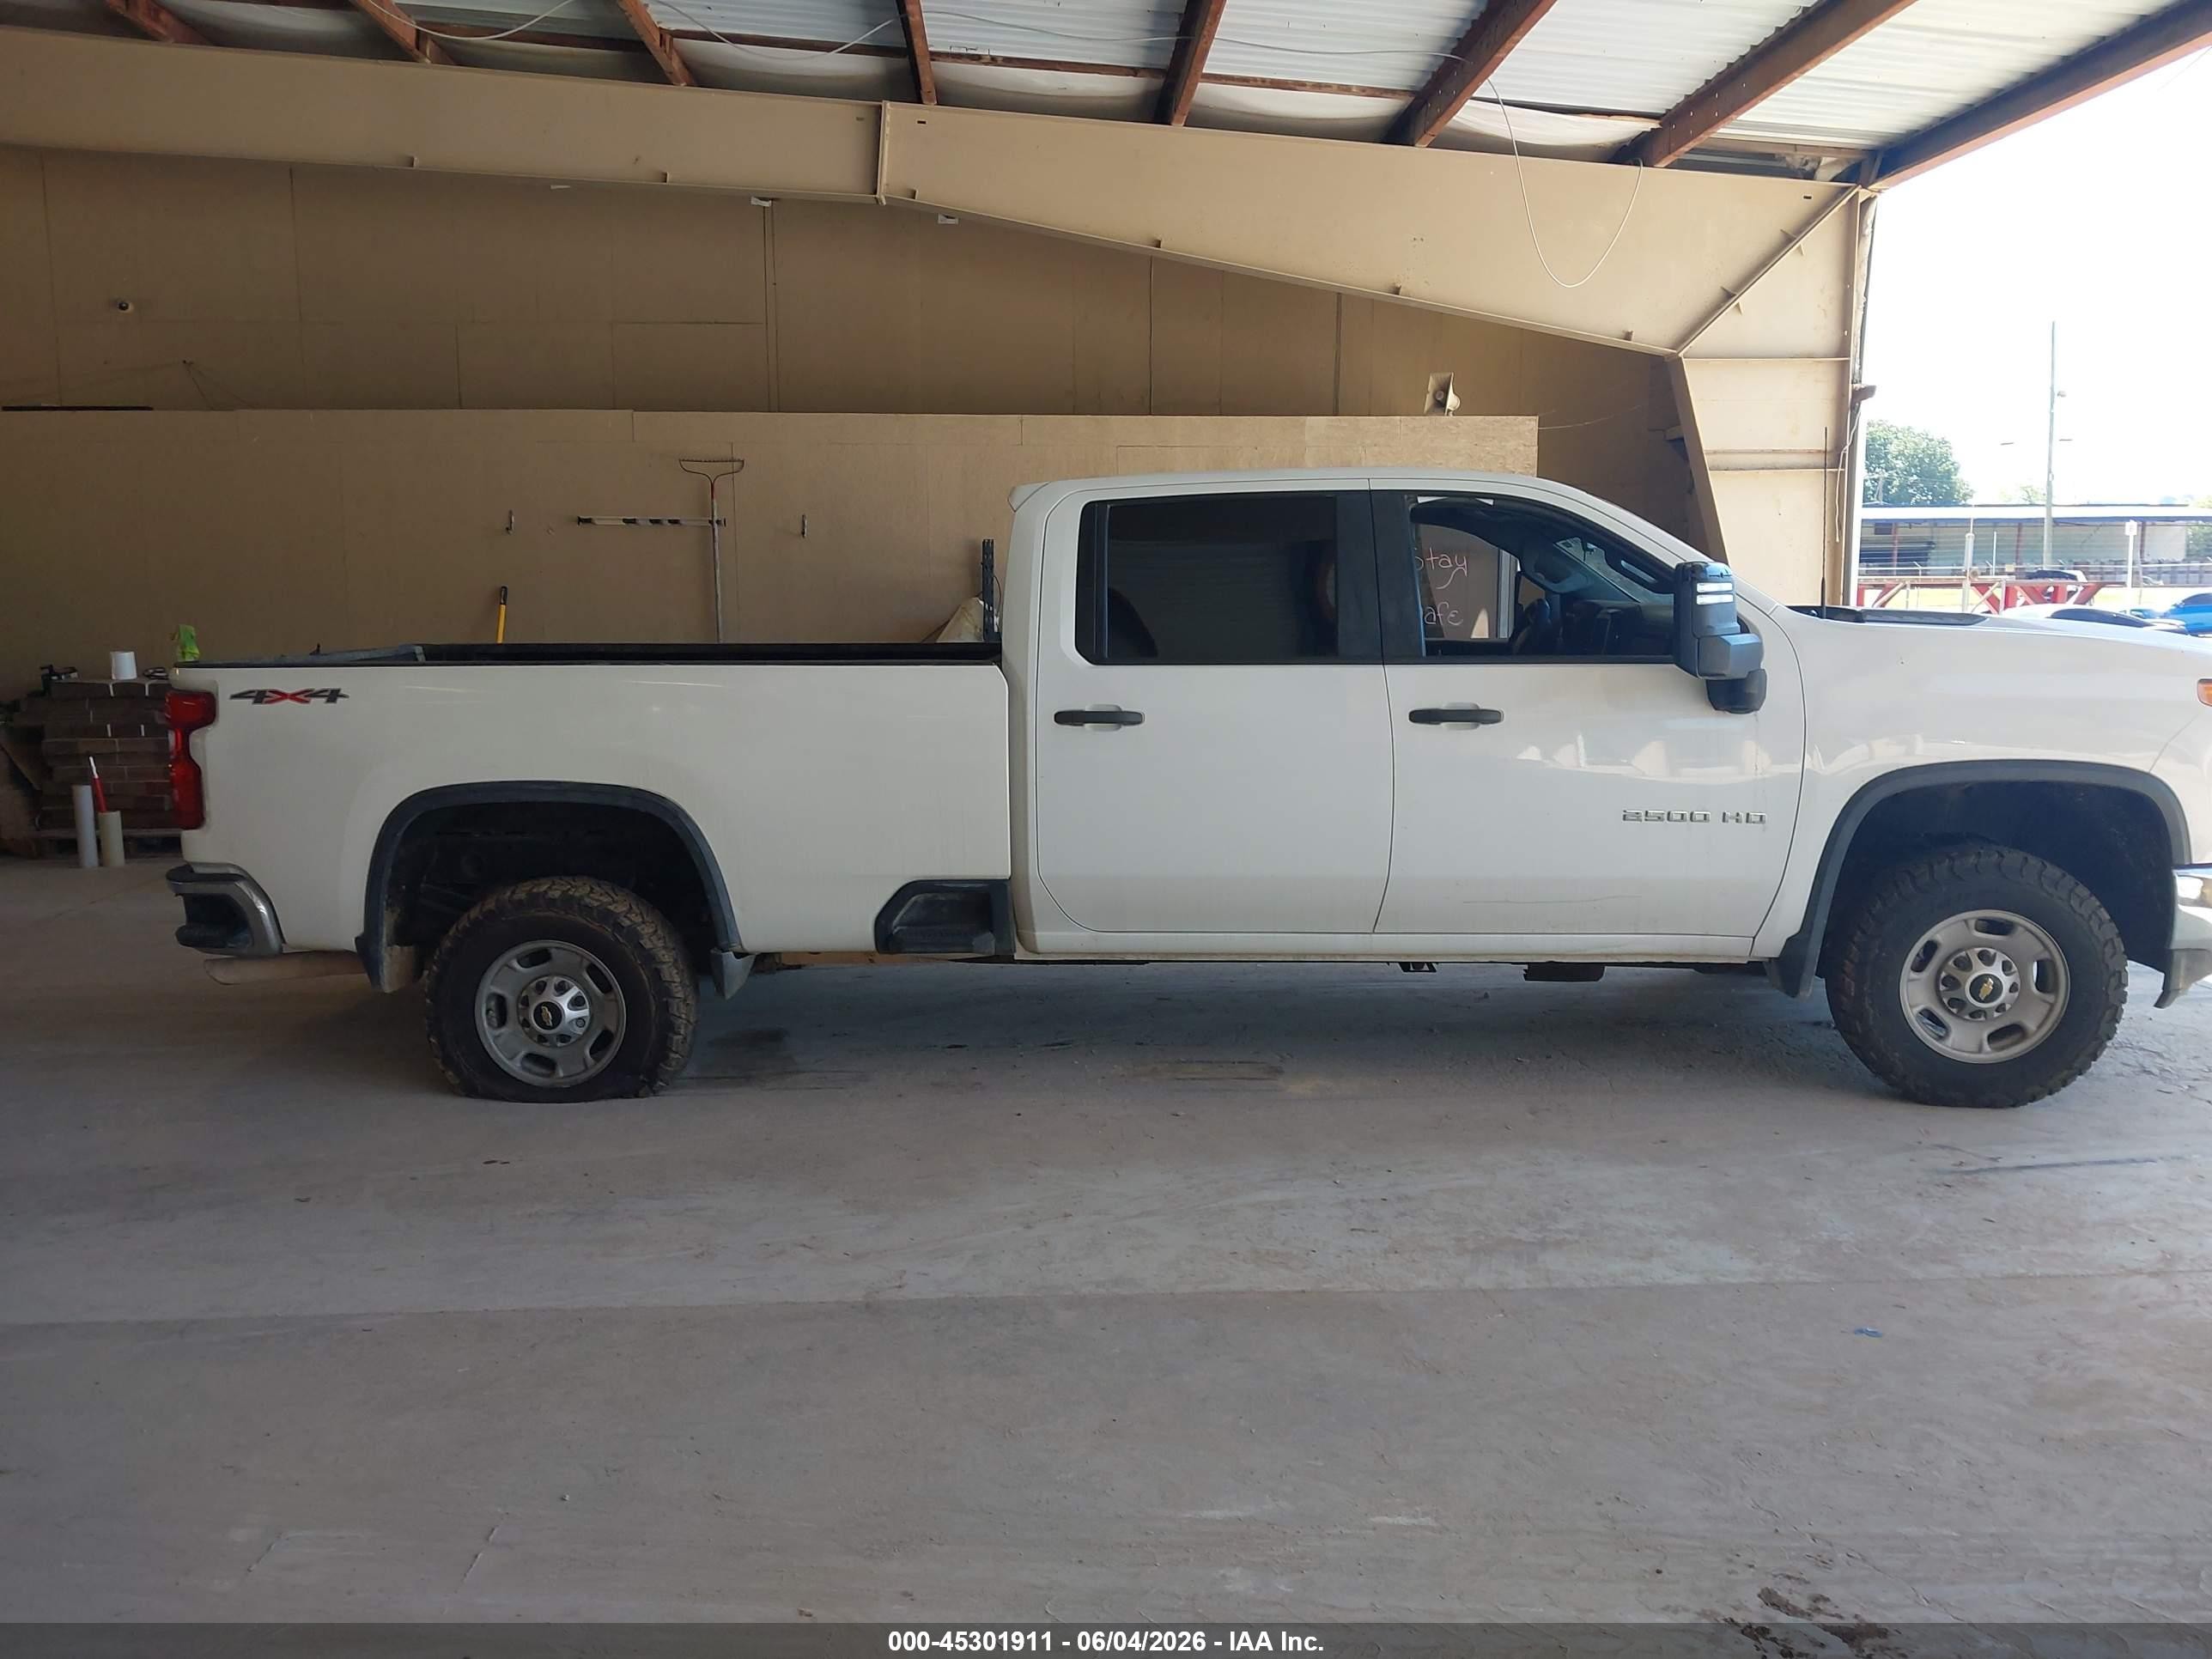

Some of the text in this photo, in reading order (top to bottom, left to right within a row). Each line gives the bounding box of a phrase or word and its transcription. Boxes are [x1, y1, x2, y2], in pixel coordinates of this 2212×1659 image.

[1424, 601, 1463, 626] afe
[1622, 810, 1766, 823] 2500 HD
